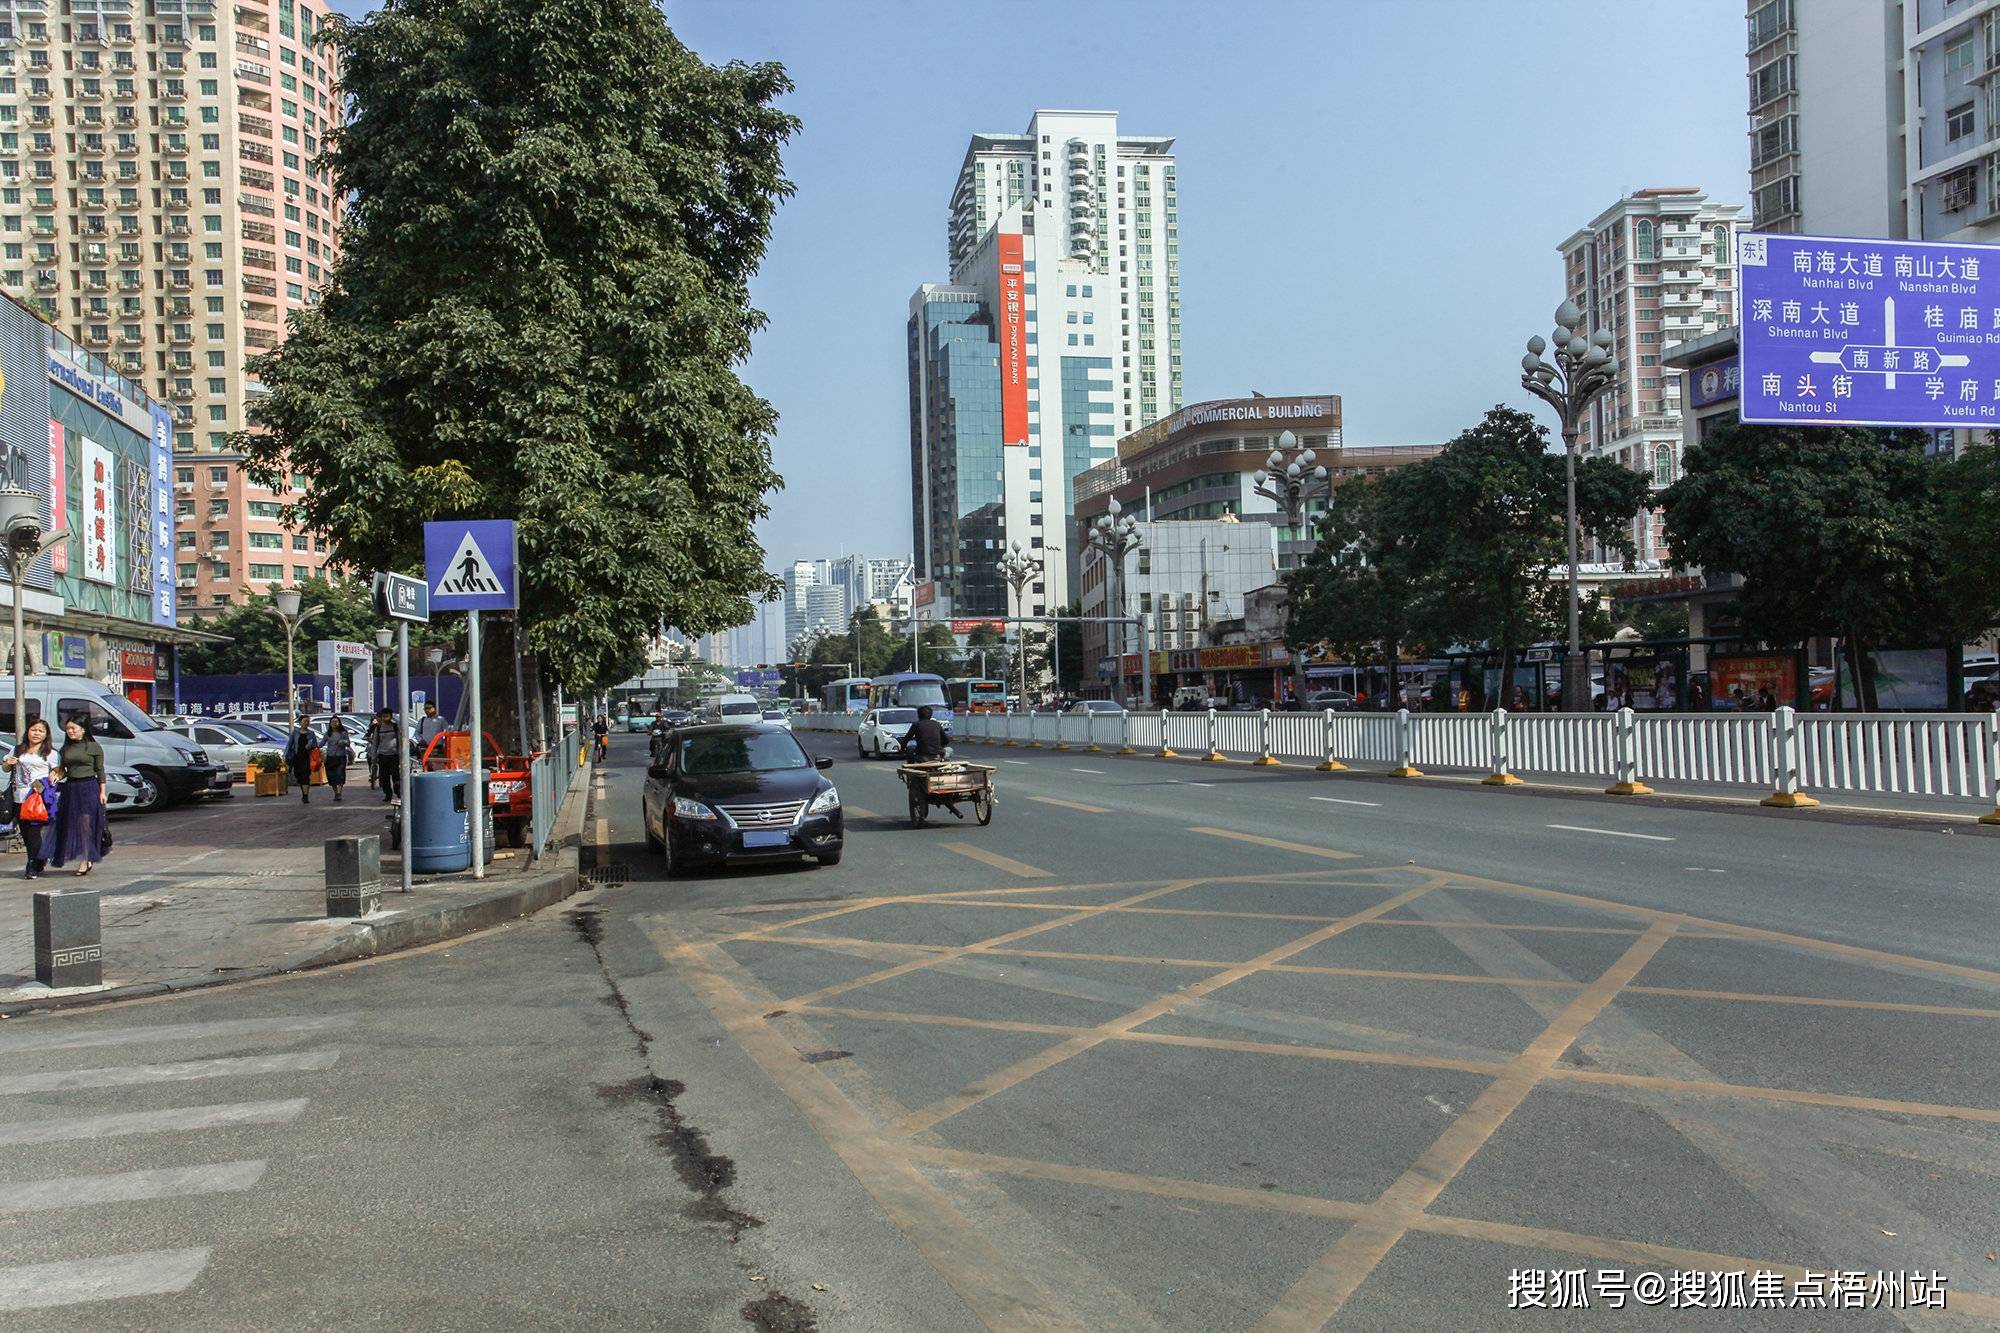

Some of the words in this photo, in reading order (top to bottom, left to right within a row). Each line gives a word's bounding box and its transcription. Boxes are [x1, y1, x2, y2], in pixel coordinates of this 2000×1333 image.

[1743, 240, 1756, 258] 东
[1793, 249, 1883, 277] 南海大道
[1895, 255, 1980, 281] 南山大道
[1803, 277, 1844, 289] Nanhai
[1848, 279, 1874, 290] Blvd
[1899, 281, 1949, 293] Nanshan
[1952, 282, 1976, 294] Blvd
[1006, 278, 1019, 324] 平安银行
[1752, 299, 1860, 326] 深南大道
[1768, 326, 1818, 339] Shennan
[1823, 328, 1848, 339] Blvd
[1937, 332, 1983, 344] Guimiao
[1853, 349, 1930, 371] 南新路
[1762, 372, 1853, 399] 南头街
[1191, 405, 1262, 426] COMMERCIAL
[1268, 405, 1322, 418] BUILDING
[1779, 401, 1821, 413] Nantou
[1825, 401, 1837, 413] St
[1943, 404, 1976, 416] Xuefu
[1980, 405, 1995, 416] Rd
